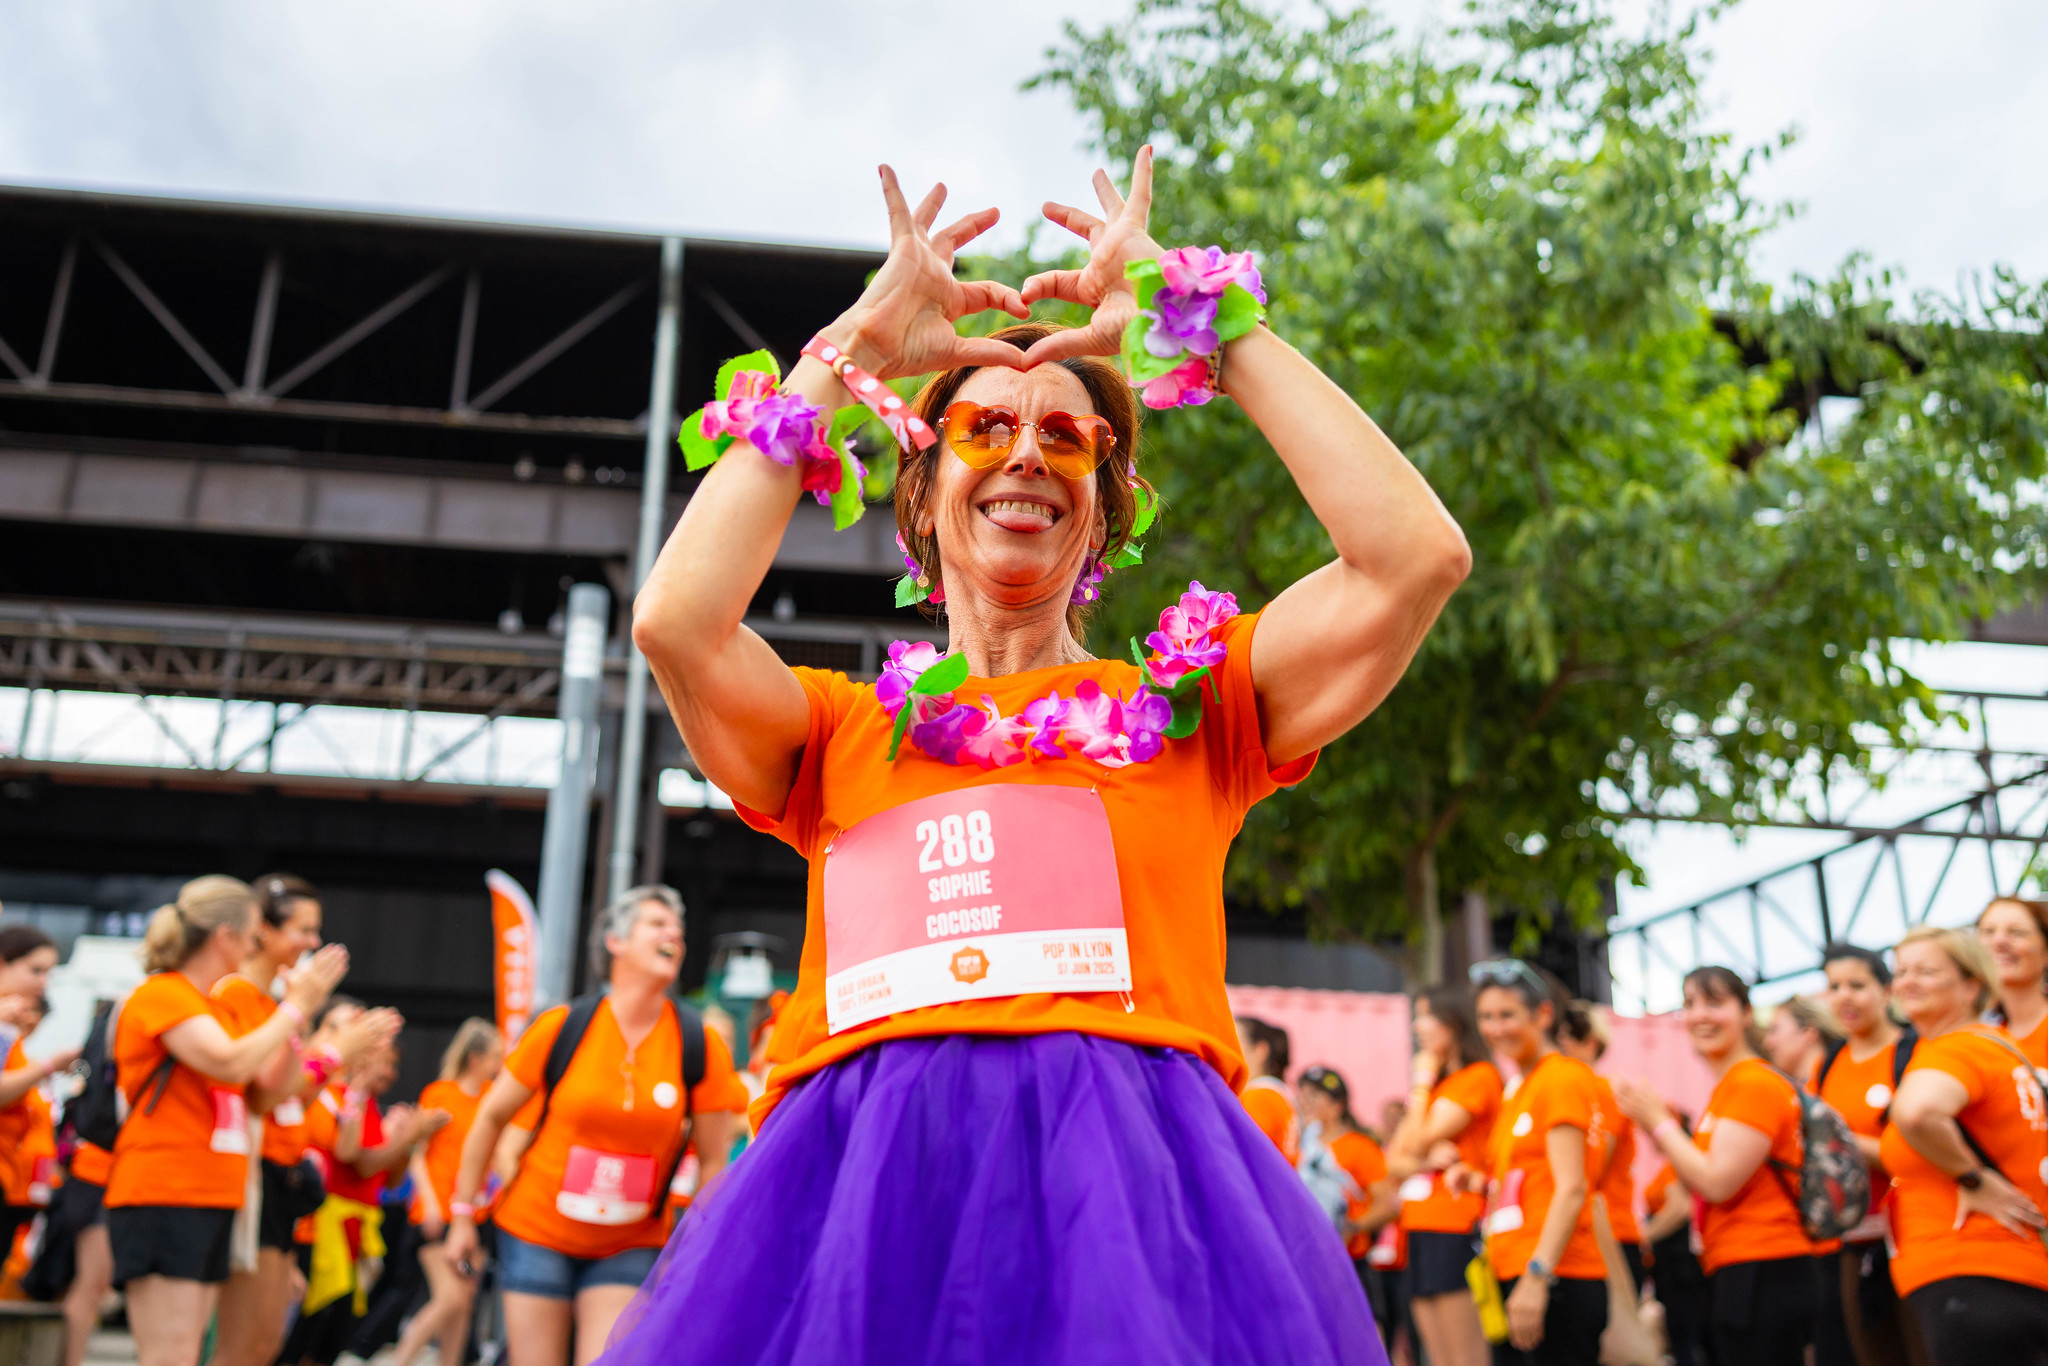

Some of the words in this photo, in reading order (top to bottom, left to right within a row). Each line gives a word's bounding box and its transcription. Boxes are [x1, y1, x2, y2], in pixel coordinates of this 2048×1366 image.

[916, 810, 995, 873] 288
[928, 869, 993, 903] SOPHIE
[926, 905, 1002, 939] COCOSOF
[1043, 942, 1065, 959] POP
[1069, 942, 1081, 958] IN
[1083, 941, 1113, 958] LYON
[1057, 962, 1068, 975] 07
[1072, 961, 1091, 975] JUIN
[1093, 961, 1115, 975] 2025
